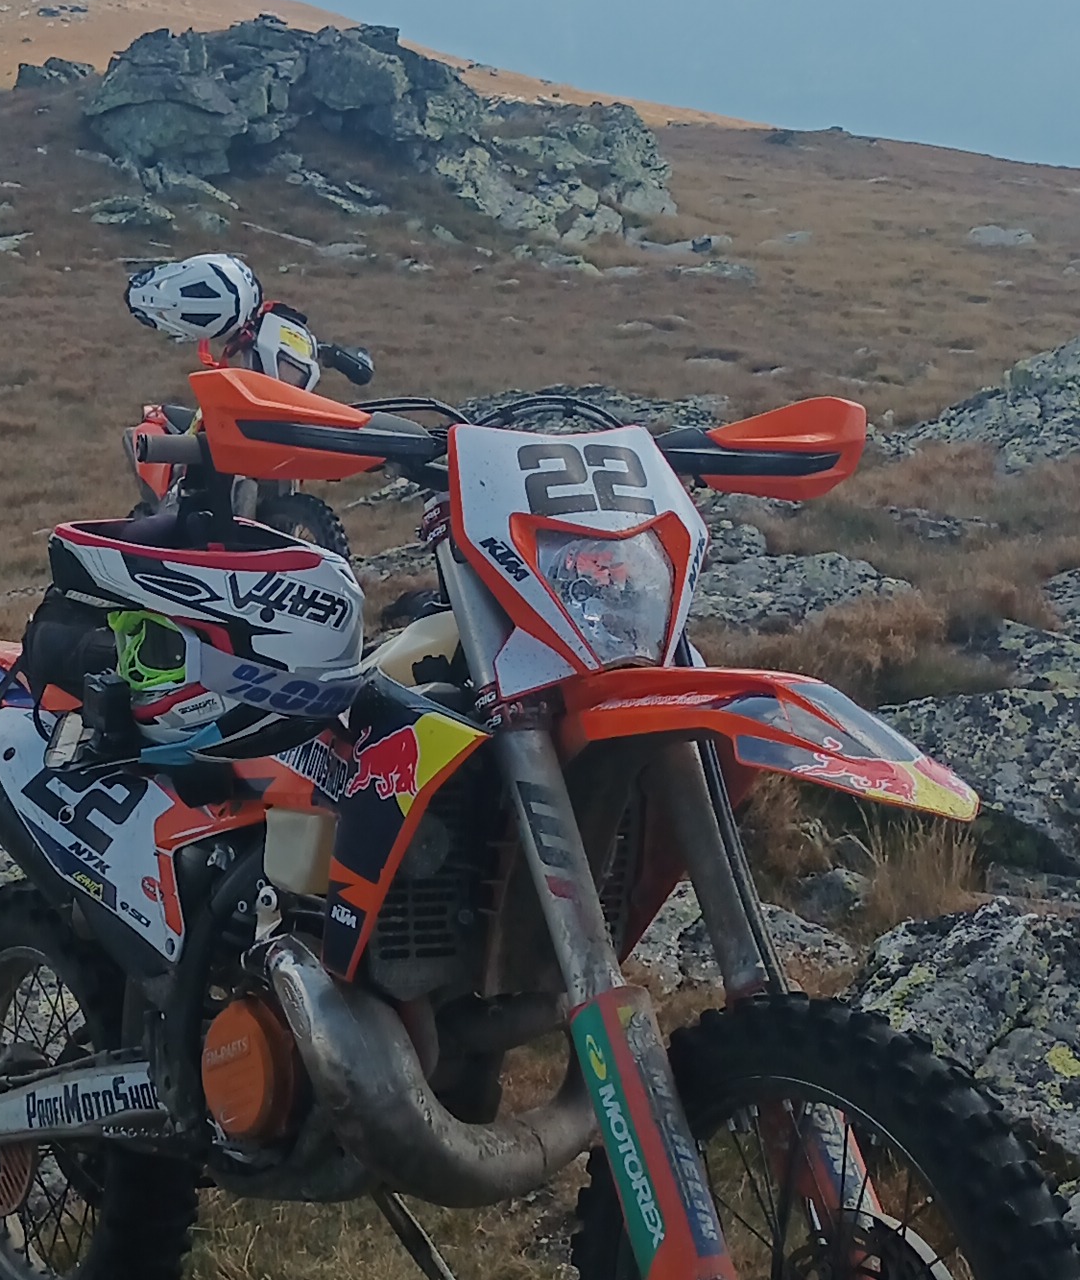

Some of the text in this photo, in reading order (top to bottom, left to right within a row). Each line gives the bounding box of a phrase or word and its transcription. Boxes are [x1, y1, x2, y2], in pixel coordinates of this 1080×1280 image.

[517, 443, 656, 516] 22
[480, 537, 529, 582] KTM
[68, 840, 112, 876] NYK
[330, 904, 357, 929] KTM
[598, 1085, 666, 1250] MOTOREX
